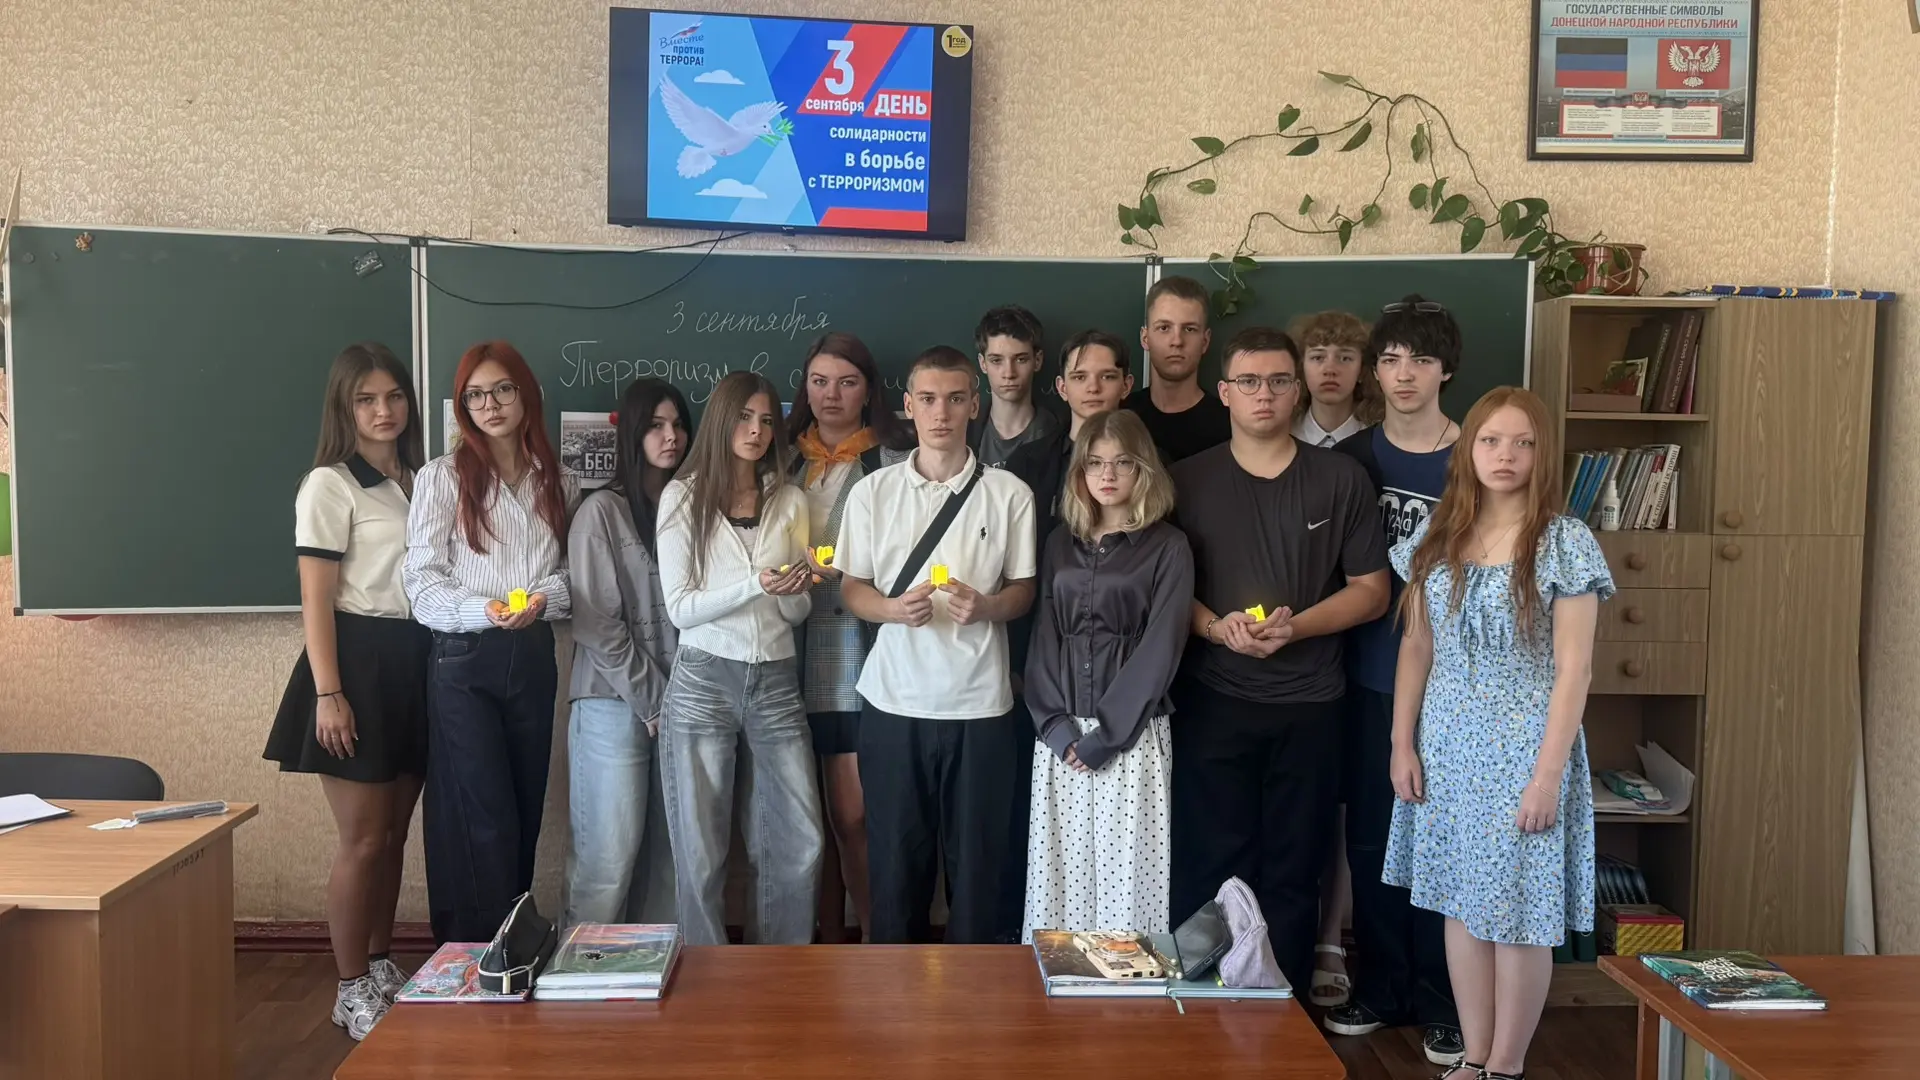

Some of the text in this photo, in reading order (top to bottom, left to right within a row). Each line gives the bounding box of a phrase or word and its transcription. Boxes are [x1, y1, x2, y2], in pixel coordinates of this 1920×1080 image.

[1566, 5, 1724, 16] ГОСУДАРСТВЕННЫЕ СИМВОЛЫ
[1551, 16, 1738, 29] ДОНЕЦКОЙ НАРОДНОЙ РЕСПУБЛИКИ
[659, 33, 704, 49] Вместе
[673, 45, 704, 55] против
[660, 54, 704, 66] ТЕРРОРА!
[824, 40, 855, 95] 3
[806, 97, 864, 115] сентября
[874, 94, 928, 117] ДЕНЬ
[830, 126, 927, 143] солидарности
[845, 149, 925, 172] в борьбе
[808, 174, 925, 194] с ТЕРРОРИЗМОМ
[666, 295, 831, 341] 3 сентября
